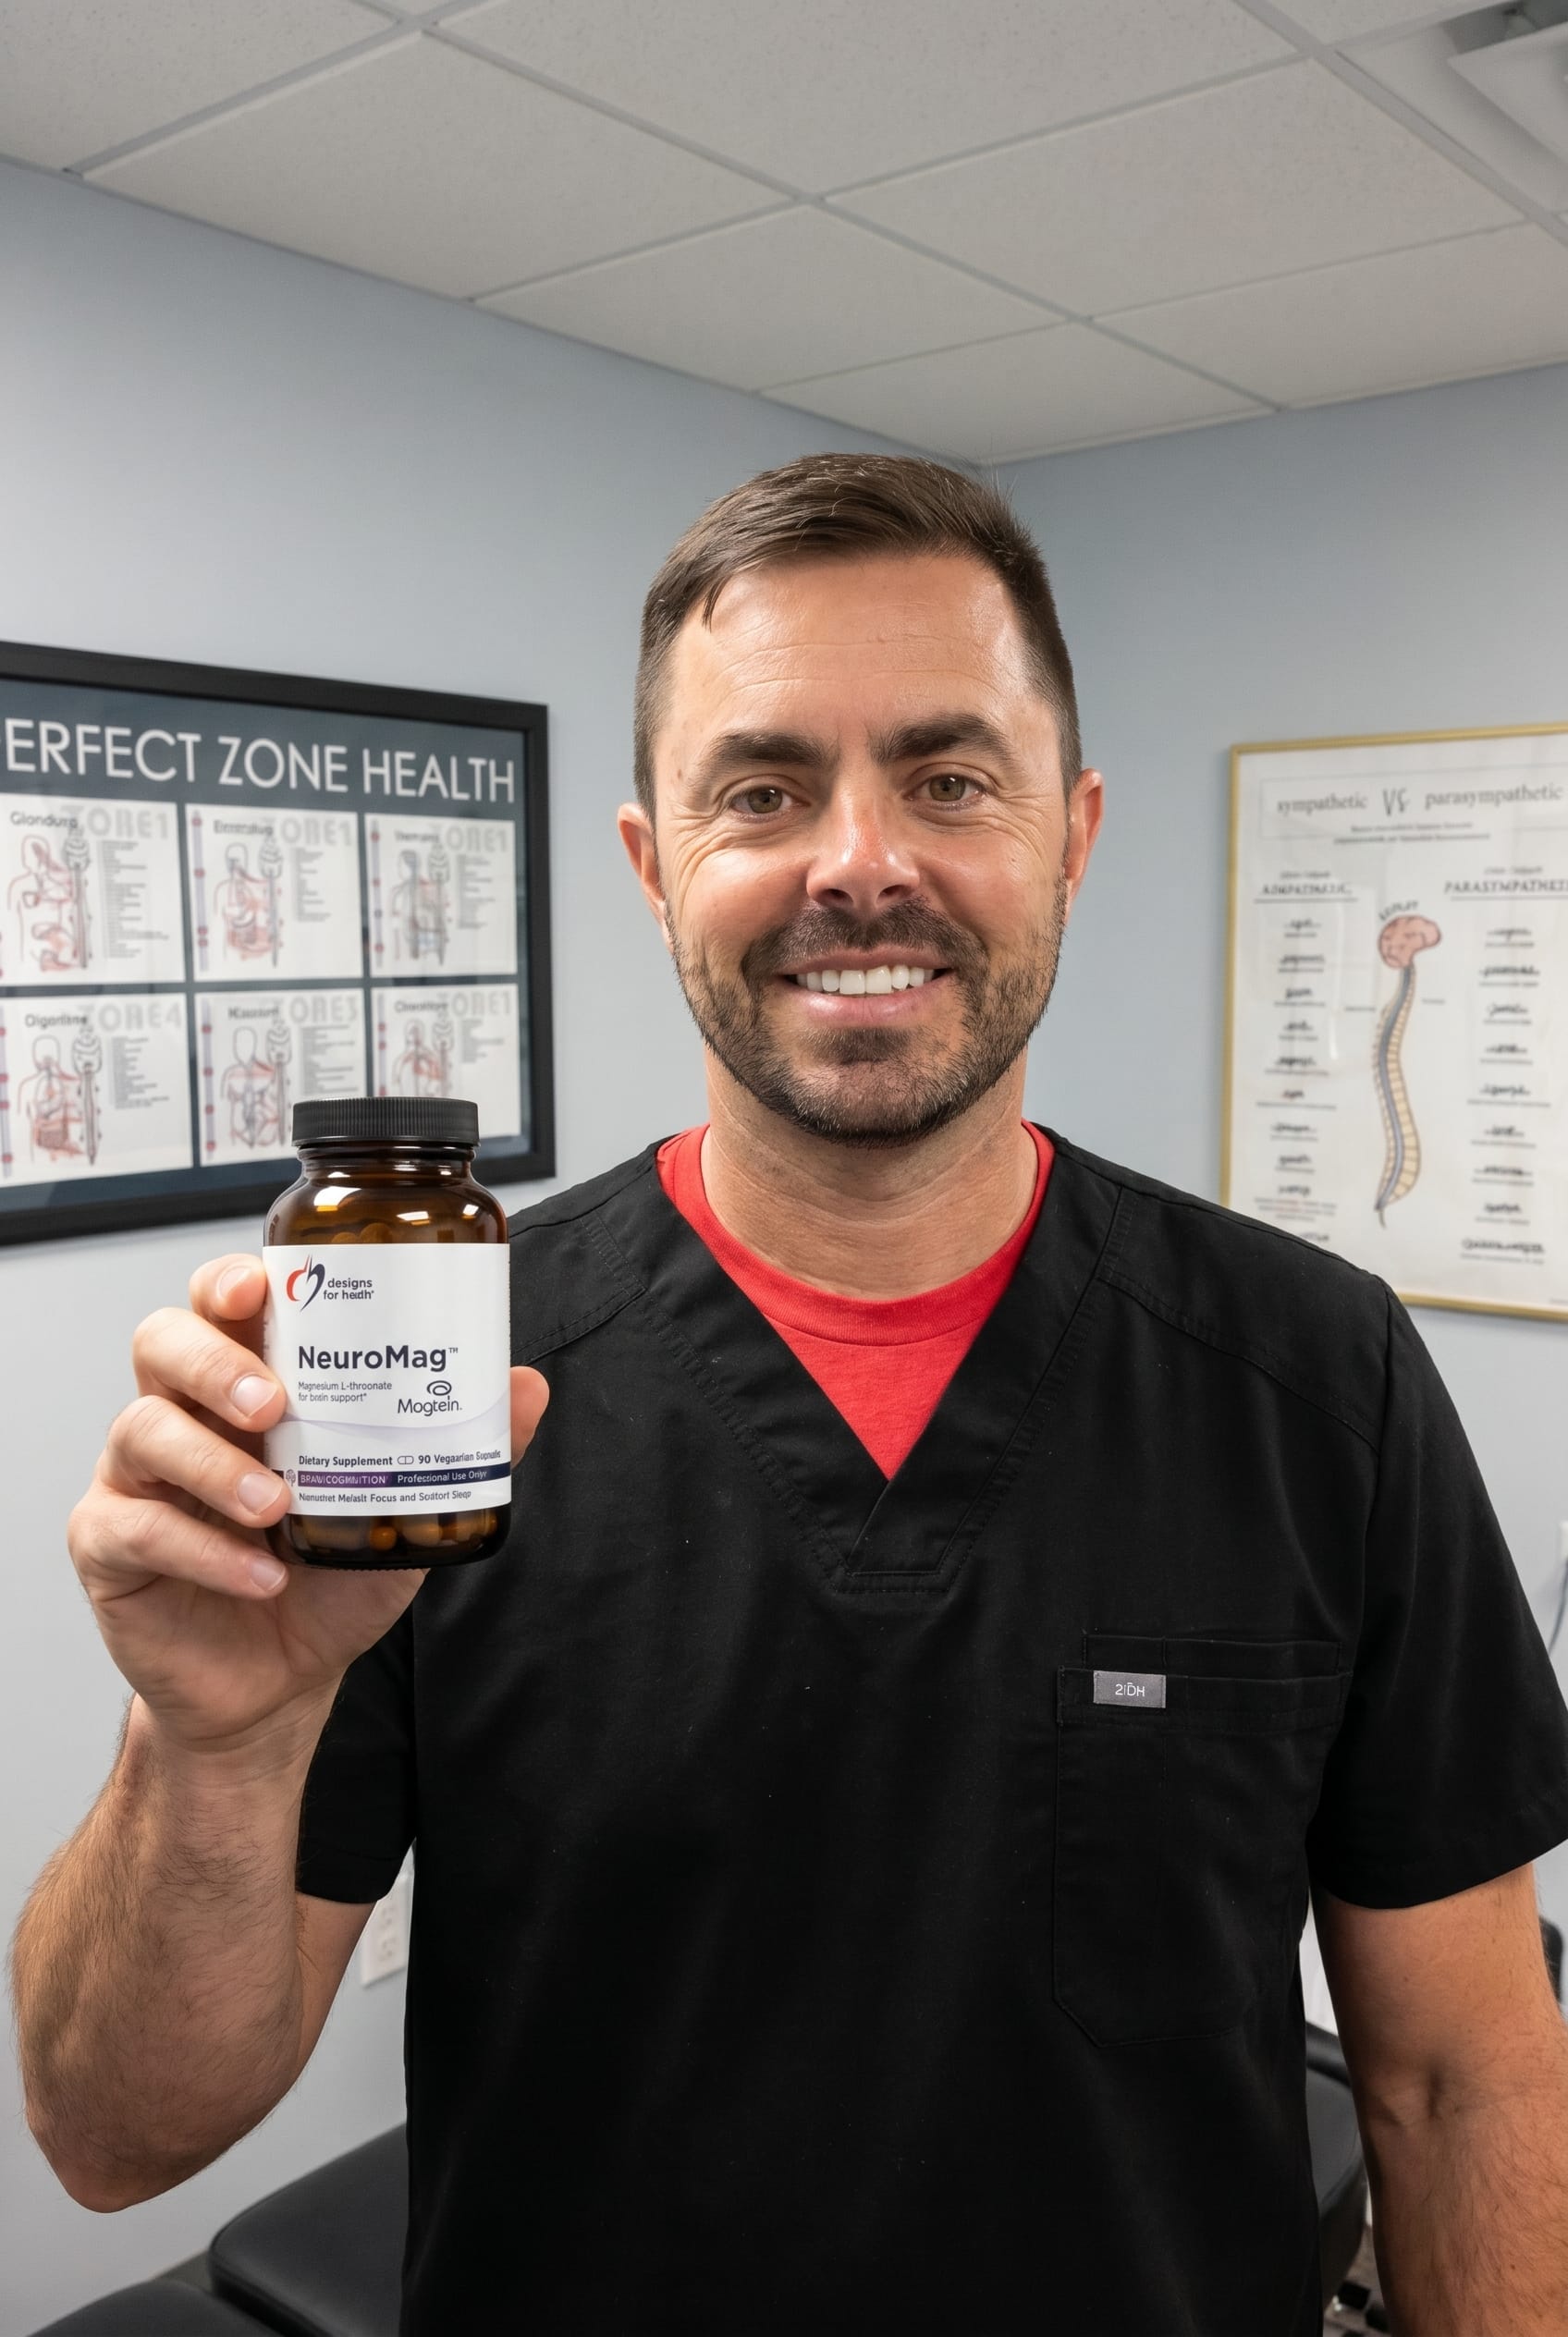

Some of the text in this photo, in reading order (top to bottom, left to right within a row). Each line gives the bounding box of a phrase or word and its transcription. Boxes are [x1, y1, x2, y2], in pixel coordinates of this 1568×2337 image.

[0, 717, 515, 803] ERFECT ZONE HEALTH
[1277, 790, 1368, 815] sympathetic
[1424, 782, 1564, 811] parasympathetic
[327, 1278, 373, 1290] designs
[324, 1290, 338, 1300] for
[298, 1381, 339, 1392] Magnesium
[298, 1392, 308, 1401] for
[299, 1455, 330, 1467] Dietary
[333, 1456, 393, 1467] Supplement
[418, 1454, 431, 1464] 90
[451, 1472, 467, 1481] Use
[370, 1493, 398, 1503] Focus
[399, 1493, 416, 1502] and
